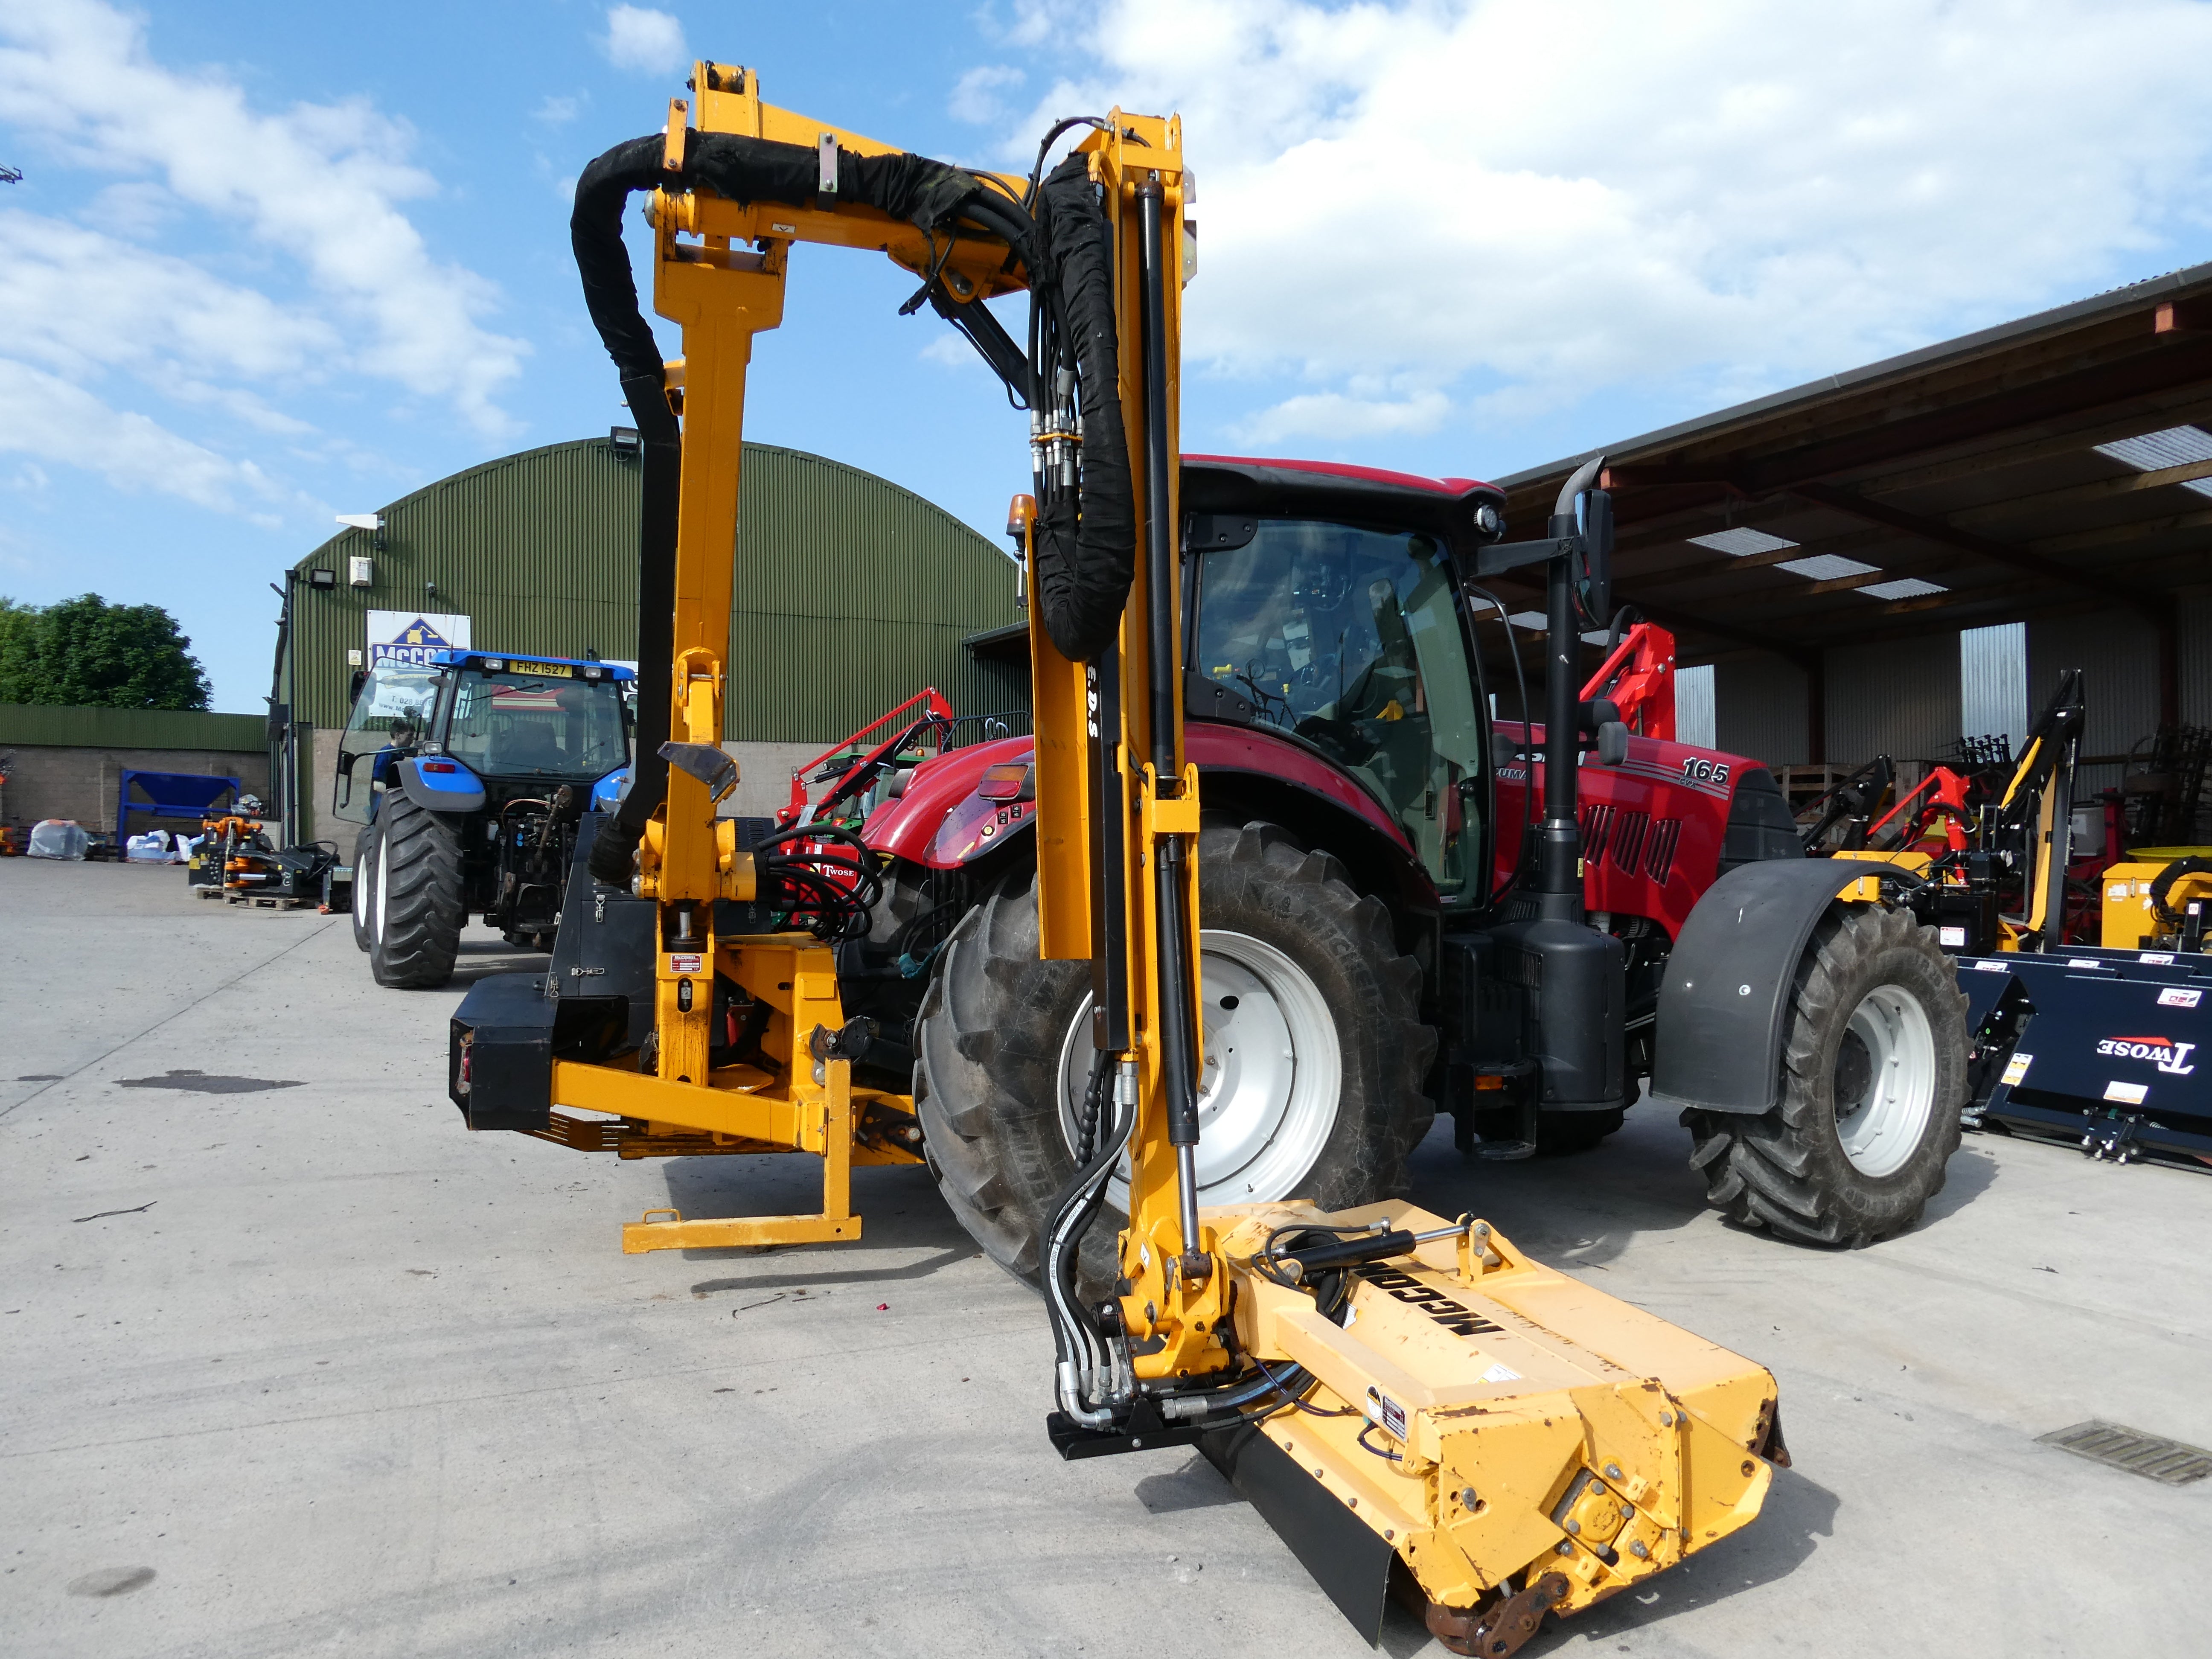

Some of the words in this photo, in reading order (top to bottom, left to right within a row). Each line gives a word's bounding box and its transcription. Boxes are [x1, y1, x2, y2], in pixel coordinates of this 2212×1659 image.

[517, 662, 538, 672] FHZ
[541, 664, 566, 675] 1527
[1683, 757, 1729, 785] 165
